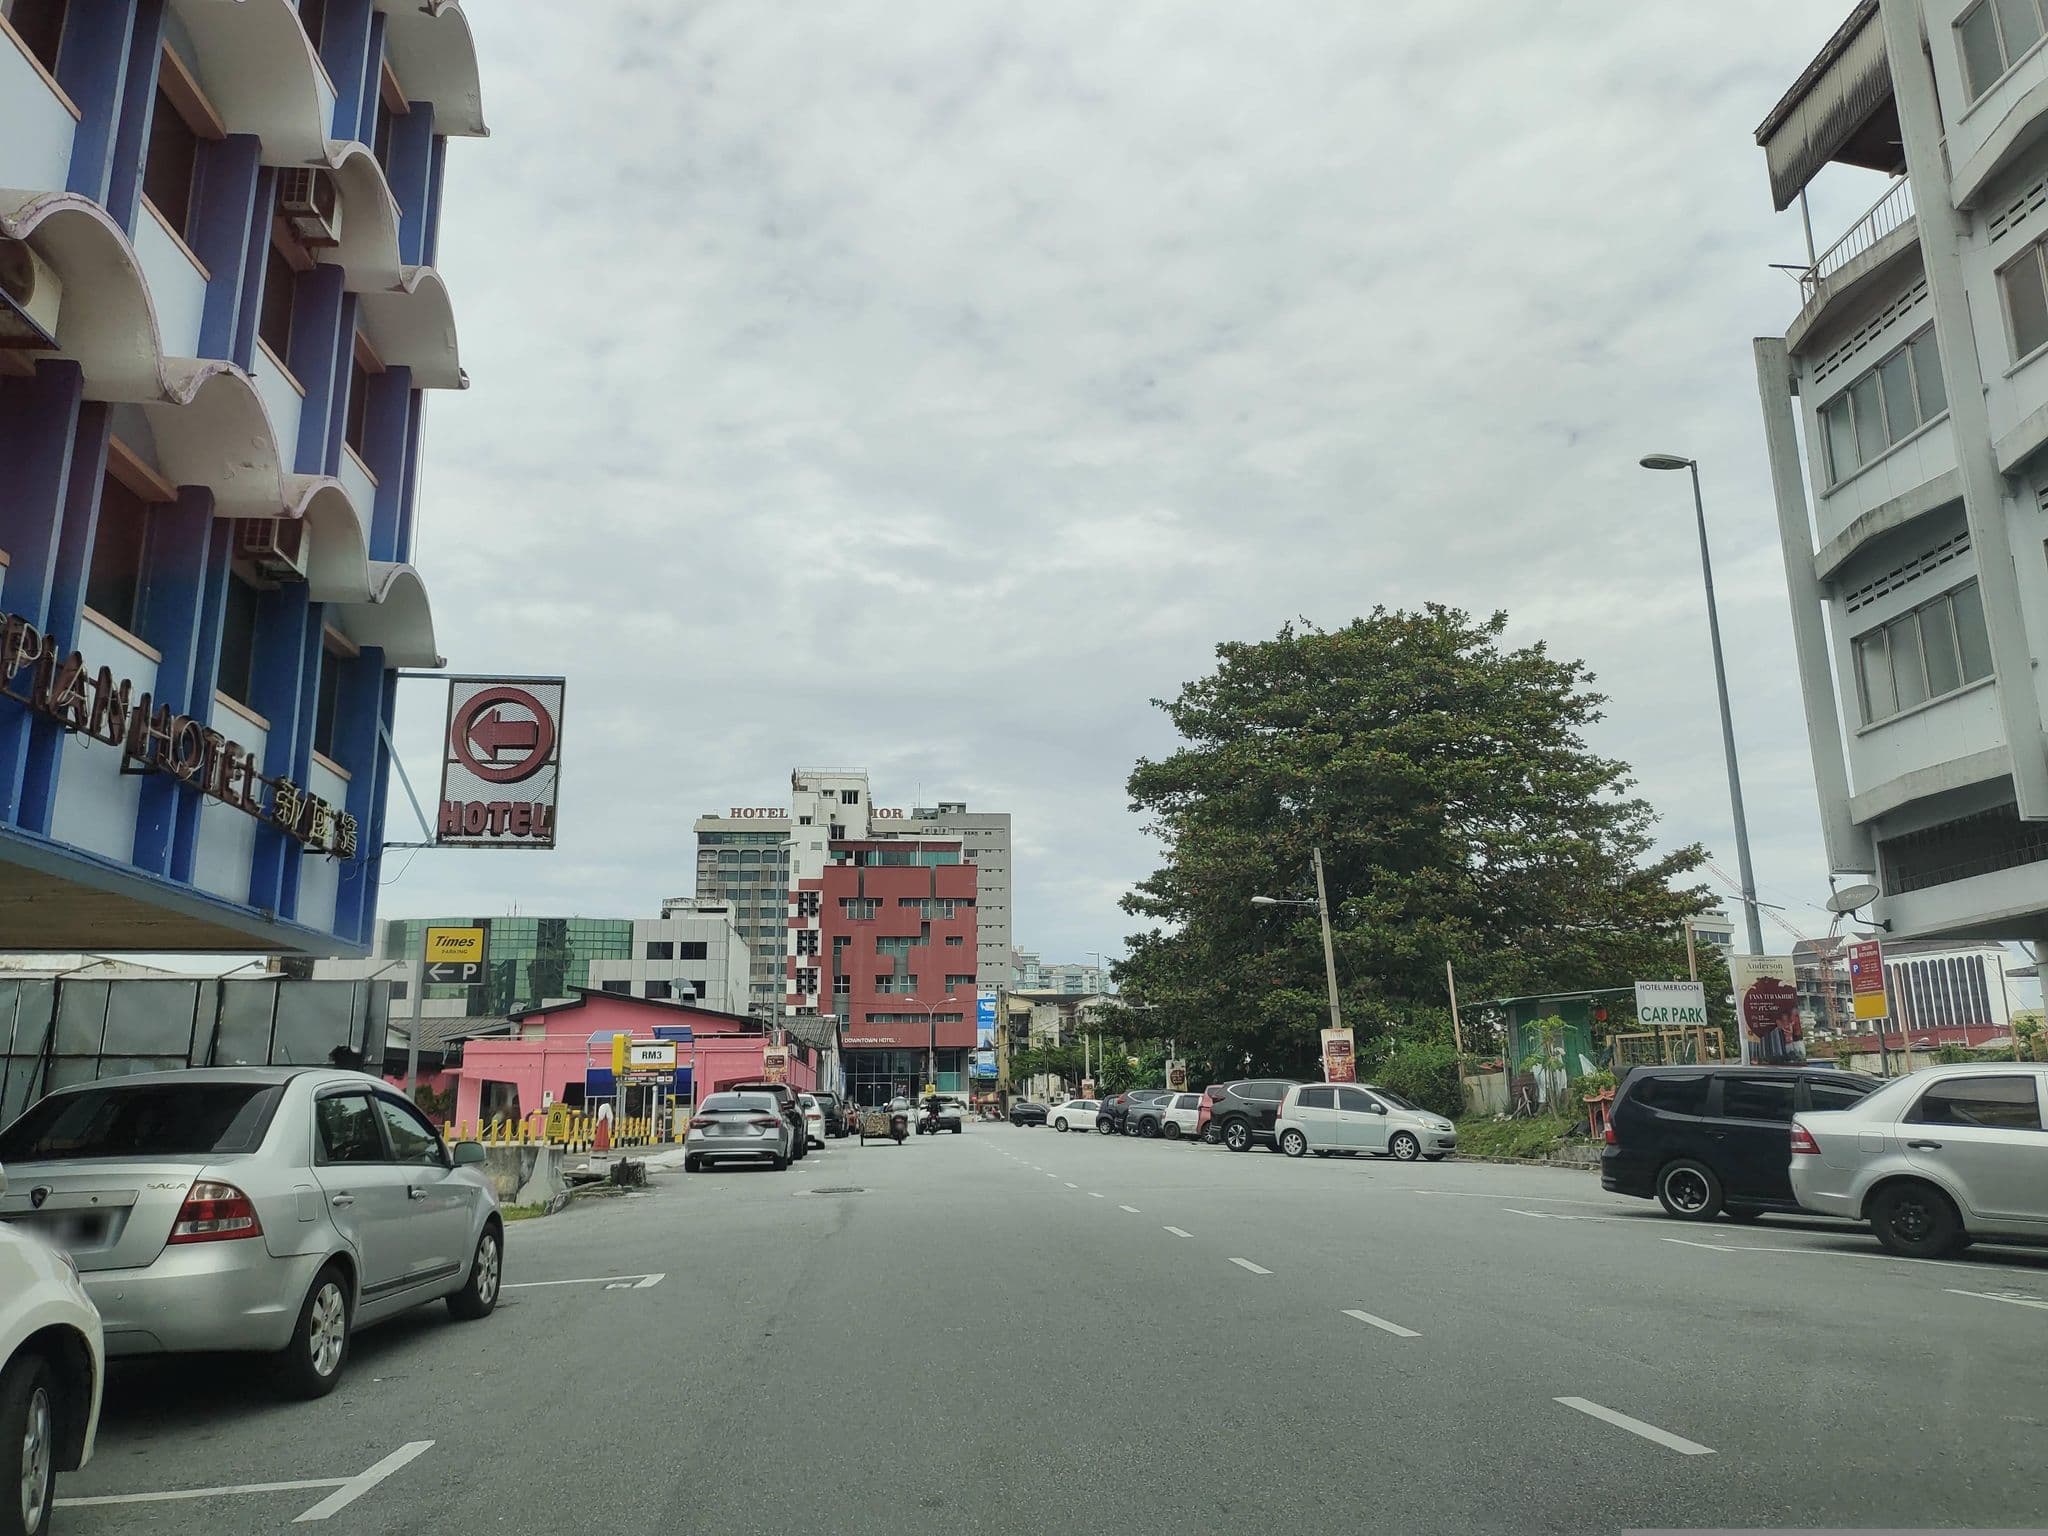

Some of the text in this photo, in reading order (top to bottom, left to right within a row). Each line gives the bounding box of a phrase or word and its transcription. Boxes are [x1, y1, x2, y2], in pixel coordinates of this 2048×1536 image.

[0, 612, 266, 813] PIAN HOTEL
[439, 800, 553, 838] HOTEL
[730, 808, 789, 819] HOTEL
[434, 935, 476, 947] Times
[462, 963, 477, 980] P
[1746, 961, 1784, 970] Anderson
[1640, 983, 1661, 991] HOTEL
[1641, 1006, 1704, 1023] CAR PARK
[641, 1050, 663, 1060] RM3
